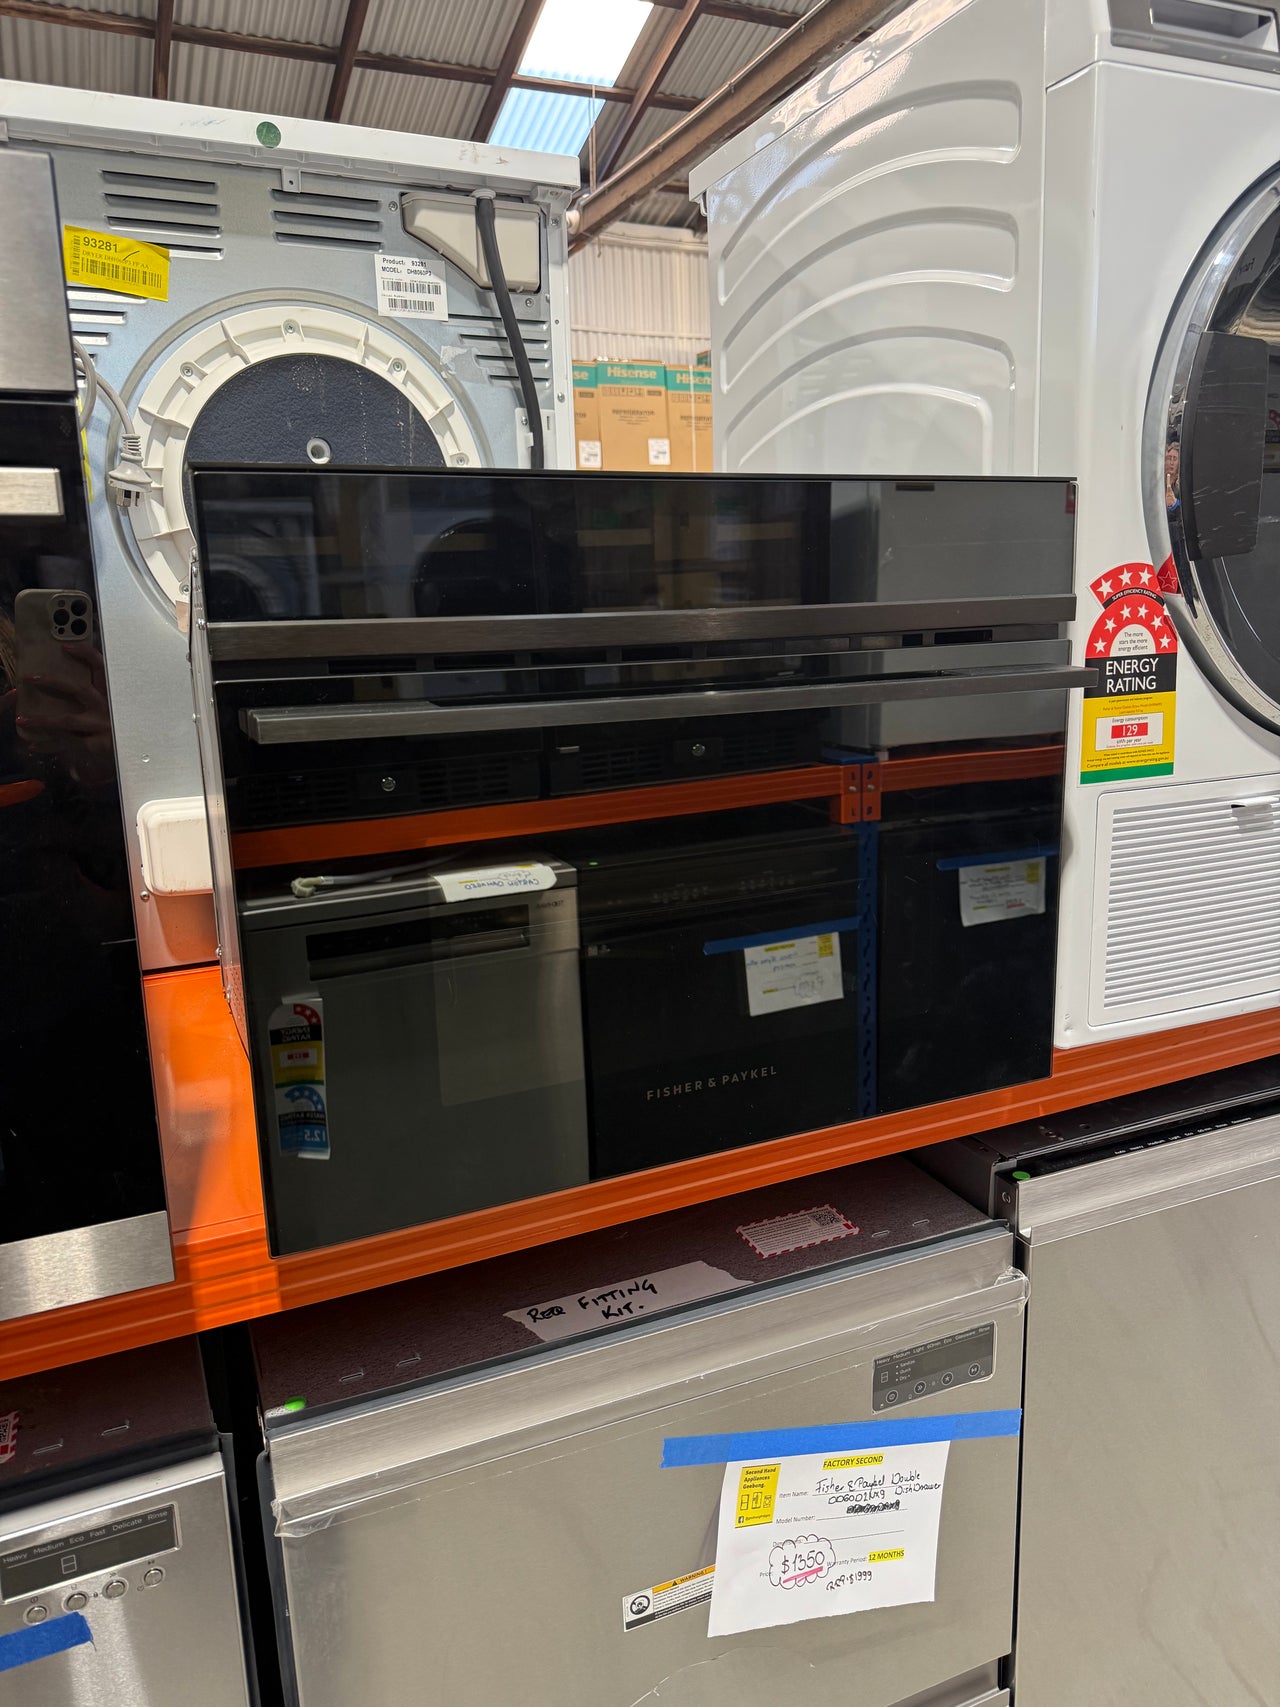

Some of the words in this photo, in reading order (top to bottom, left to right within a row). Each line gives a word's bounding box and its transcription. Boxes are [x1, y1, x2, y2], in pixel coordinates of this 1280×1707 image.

[83, 236, 118, 253] 93281
[606, 366, 657, 379] Hisense
[1106, 657, 1159, 675] ENERGY
[1106, 676, 1157, 693] RATING
[1122, 724, 1138, 736] 129
[646, 1080, 703, 1100] FISHER
[707, 1077, 717, 1088] &
[722, 1066, 777, 1085] PAYKEL
[577, 1279, 658, 1310] FITTING
[823, 1457, 855, 1469] FACTORY
[855, 1455, 884, 1465] SECOND
[743, 1475, 771, 1483] Appliances
[745, 1468, 764, 1476] Second
[815, 1478, 845, 1495] Fisher
[891, 1471, 921, 1486] Double
[3, 1552, 28, 1564] Heavy
[33, 1541, 65, 1554] Medium
[69, 1535, 85, 1545] Eco
[89, 1528, 106, 1538] Fast
[112, 1518, 143, 1532] Delicate
[147, 1510, 169, 1521] Rinse
[876, 1549, 905, 1559] MONTHS
[781, 1550, 826, 1576] $1350
[679, 1570, 705, 1583] WARNING
